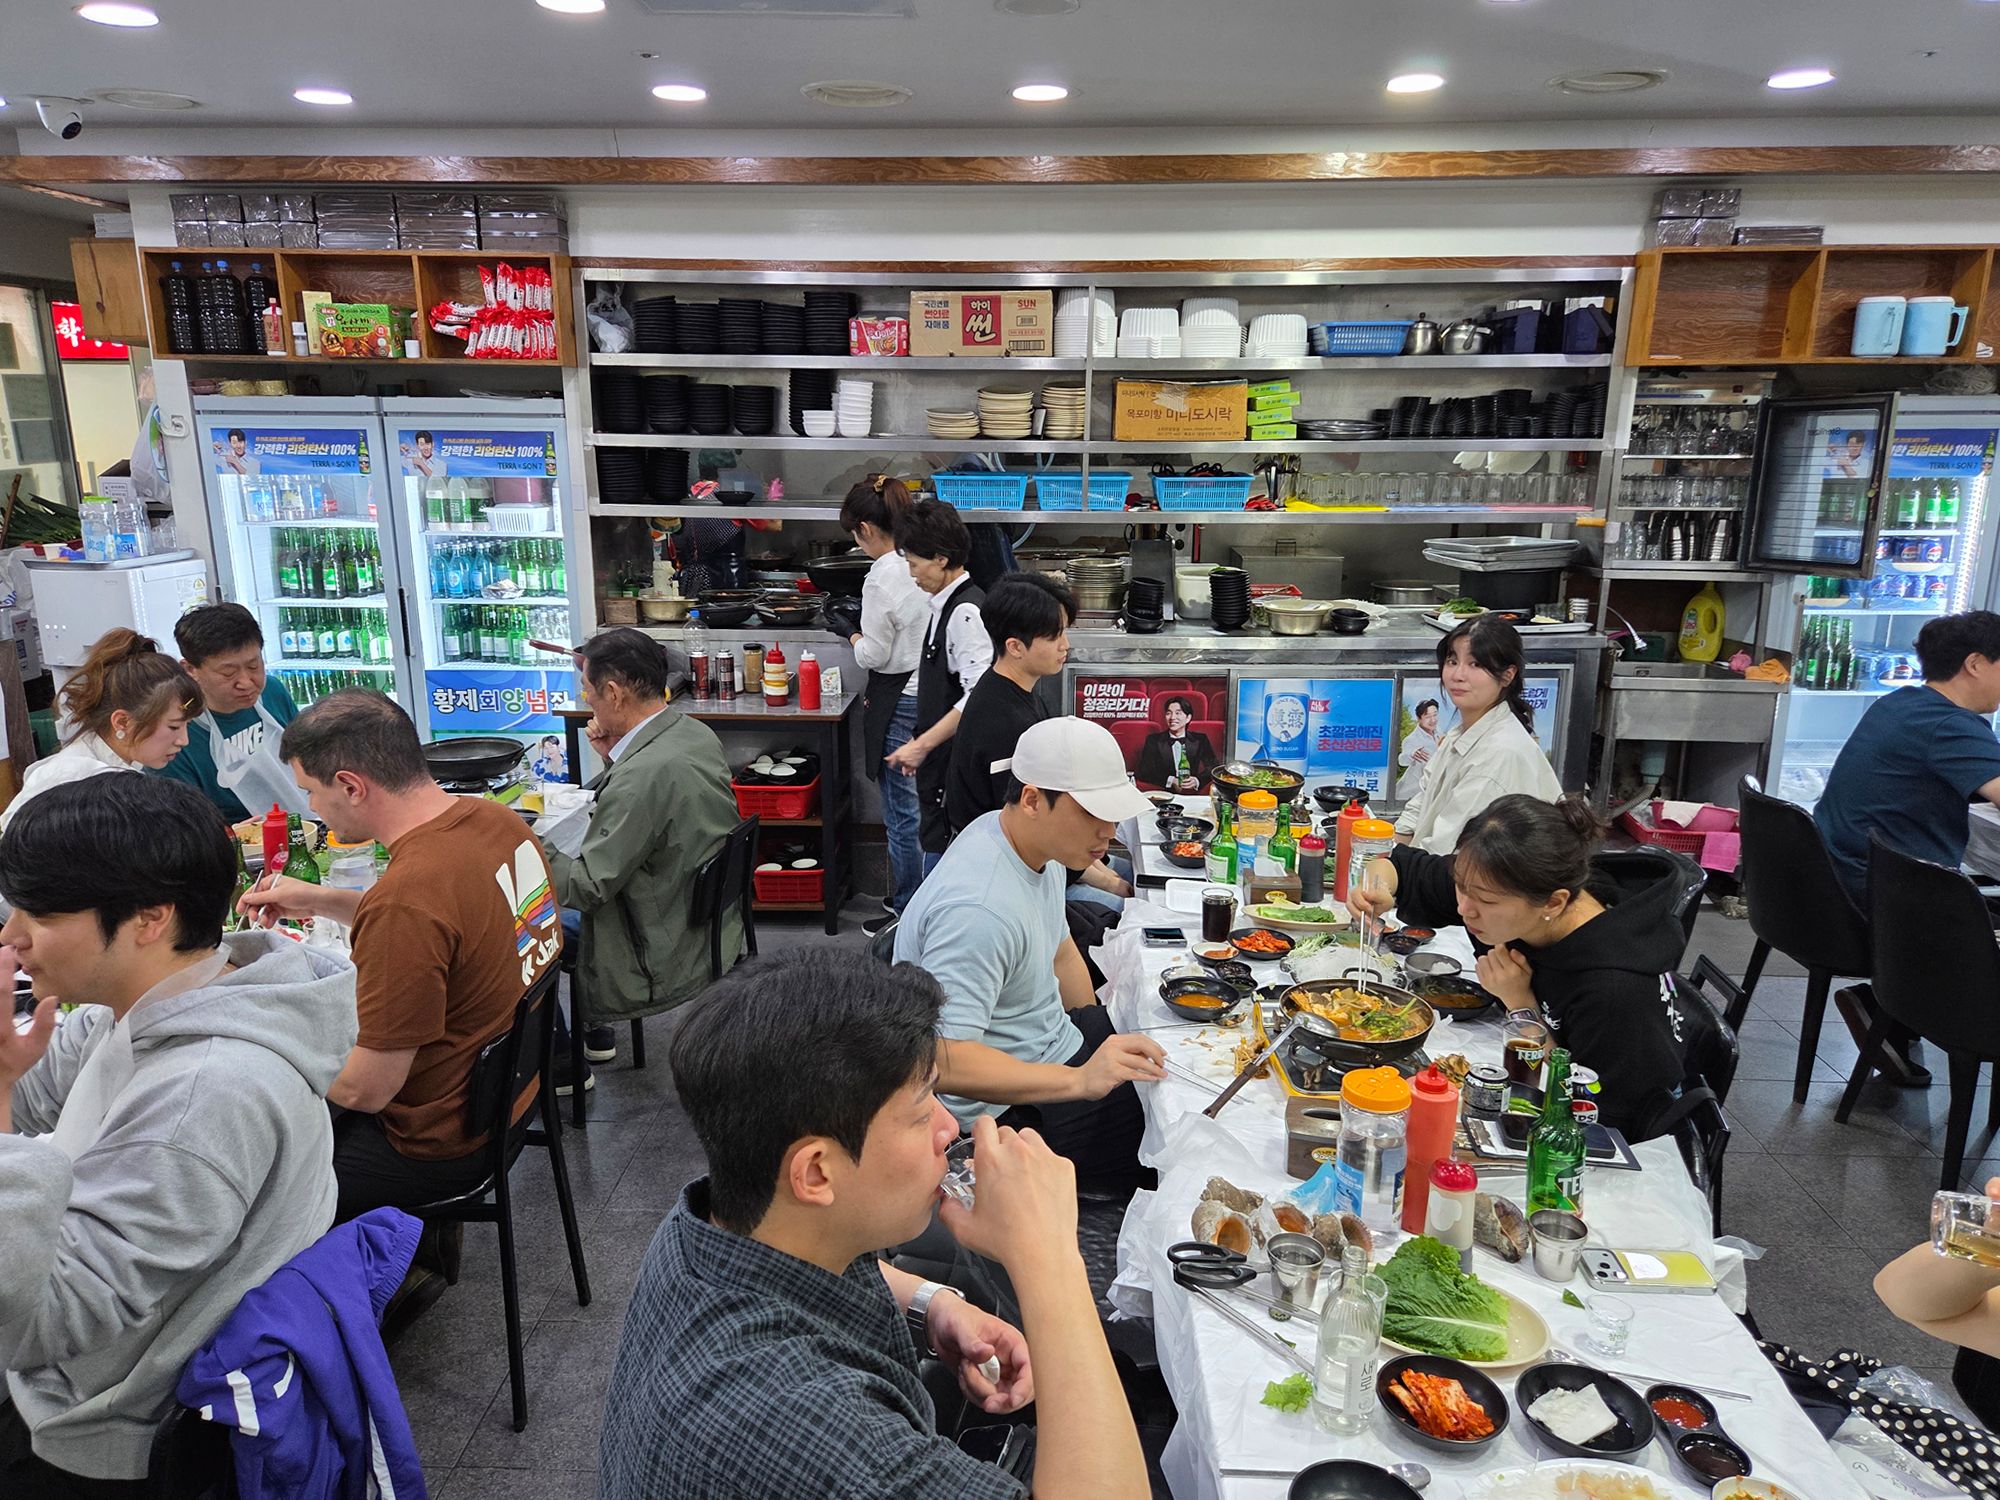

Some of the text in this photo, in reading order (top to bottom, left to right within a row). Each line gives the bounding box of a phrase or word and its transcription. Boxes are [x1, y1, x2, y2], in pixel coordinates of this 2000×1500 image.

[970, 299, 991, 311] 하이
[1017, 299, 1036, 307] SUN
[1166, 406, 1232, 422] 미니도시락
[254, 443, 356, 456] 강력한 리얼탄산 100%
[440, 444, 544, 458] 강력한 리얼탄산 100%
[1906, 443, 1953, 457] 리얼탄산
[1953, 444, 1982, 457] 100%
[312, 460, 331, 468] TERRA
[498, 462, 516, 470] TERRA
[1929, 461, 1950, 470] TERRA
[1083, 683, 1126, 697] 이 맛이
[1083, 697, 1151, 711] 청정라거다!
[222, 721, 263, 757] NIKE
